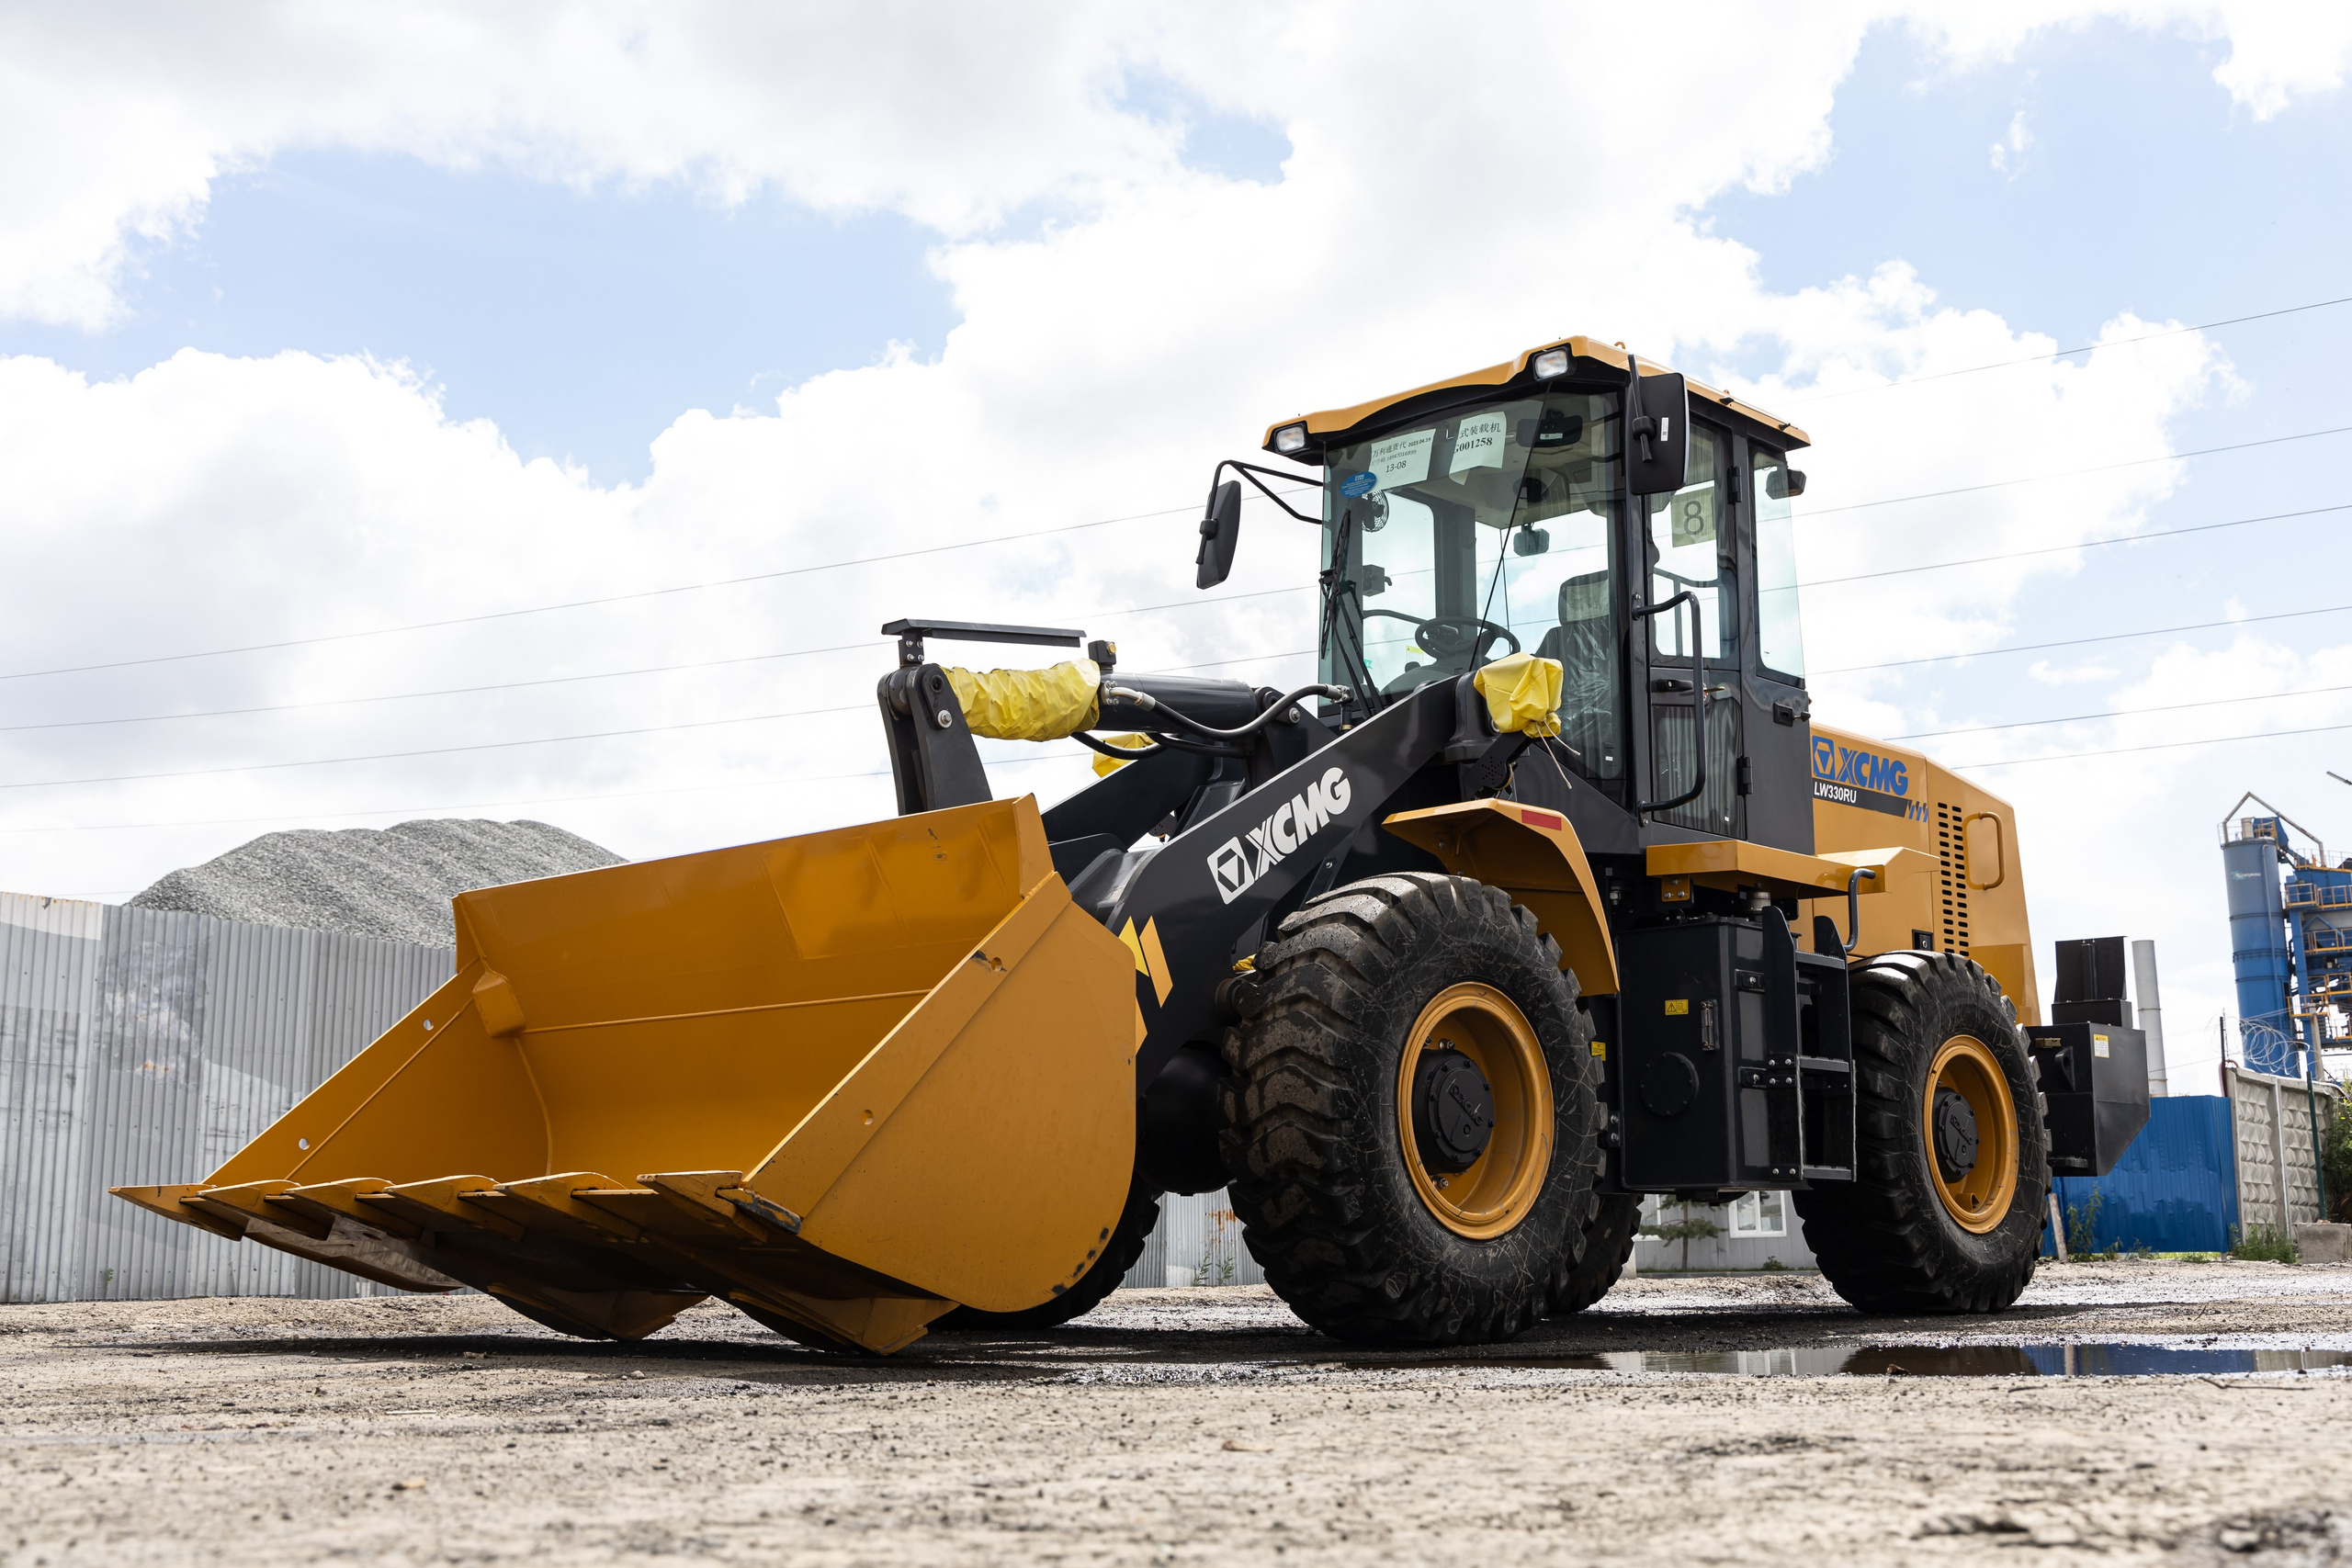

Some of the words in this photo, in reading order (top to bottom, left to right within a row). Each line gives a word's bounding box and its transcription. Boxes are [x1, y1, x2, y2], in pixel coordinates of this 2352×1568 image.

[1459, 422, 1501, 438] 式装载机
[1385, 460, 1407, 473] 13-08
[1683, 500, 1704, 536] 8
[1835, 746, 1908, 796] XCMG
[1814, 781, 1857, 804] LW330RU
[1245, 767, 1351, 882] XCMG
